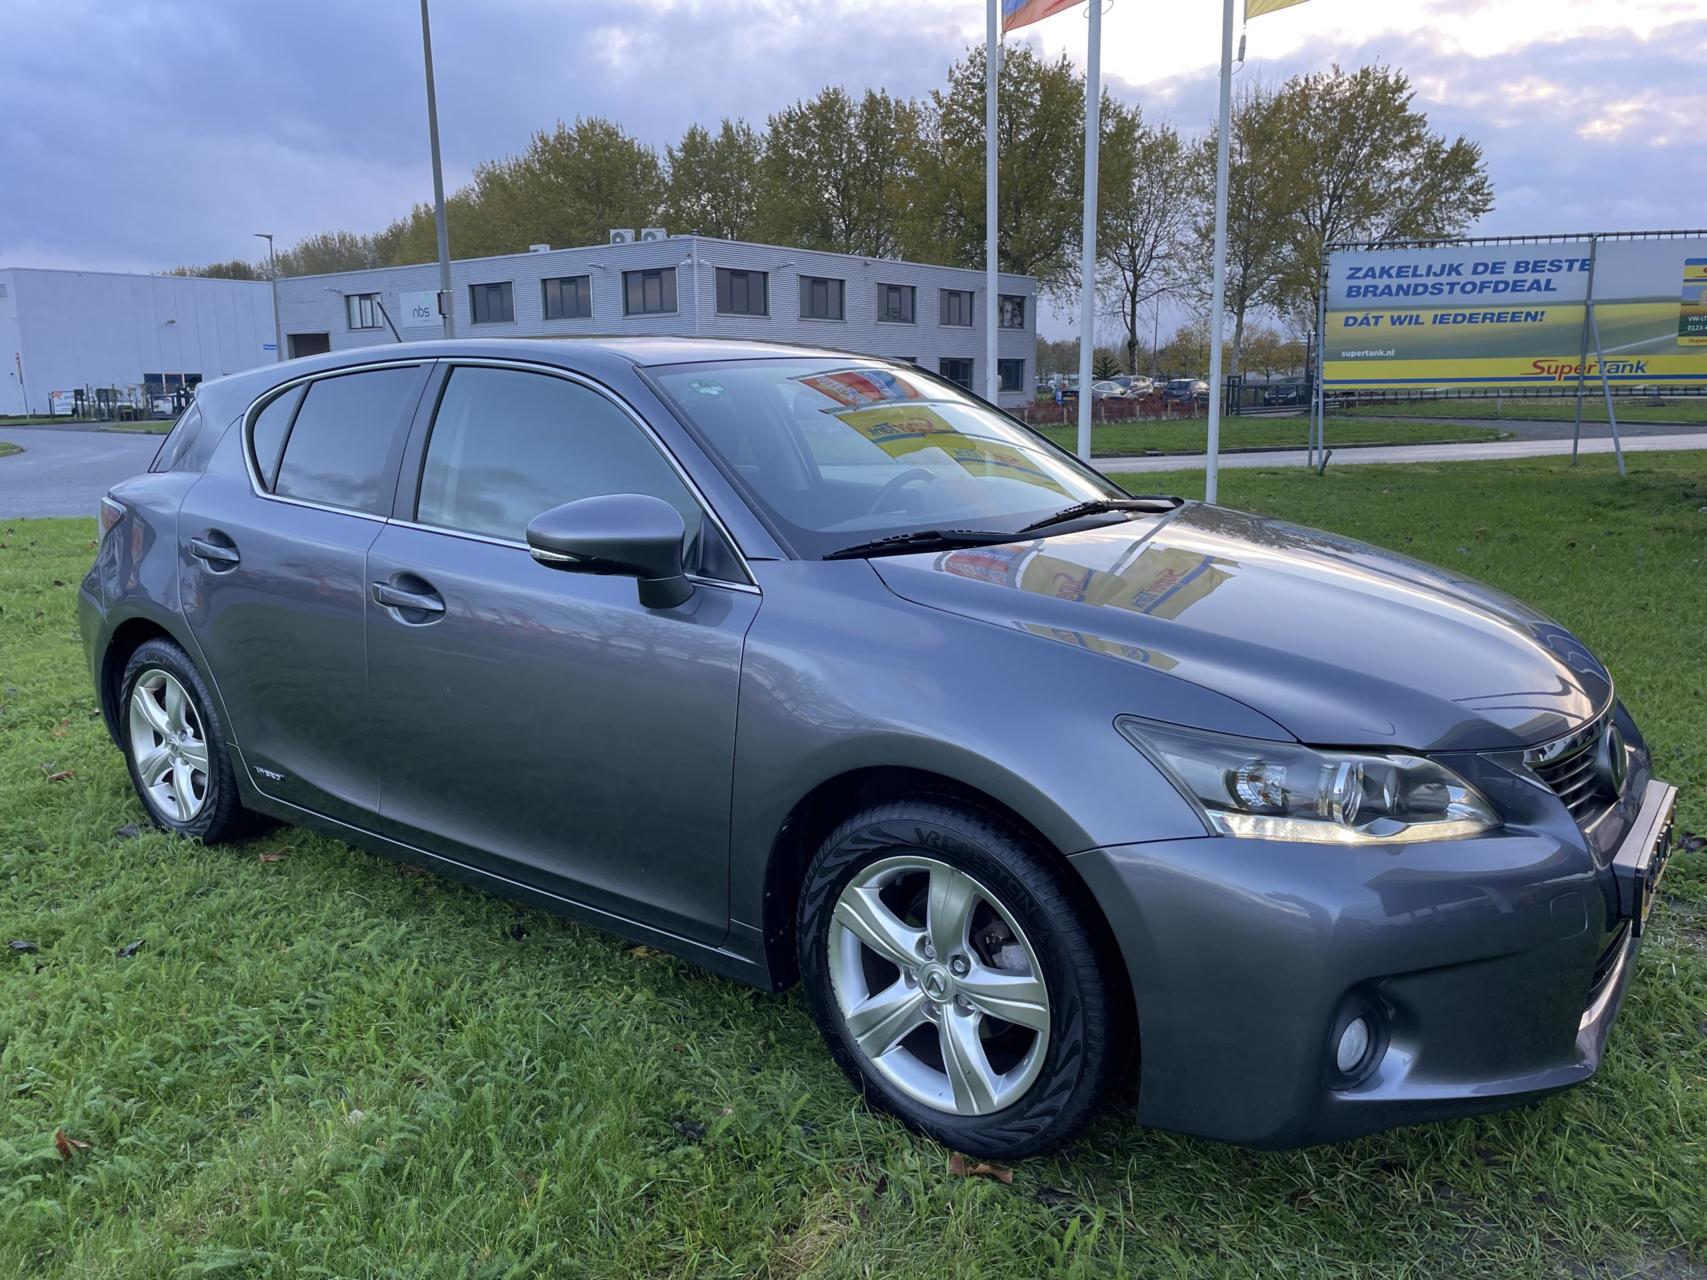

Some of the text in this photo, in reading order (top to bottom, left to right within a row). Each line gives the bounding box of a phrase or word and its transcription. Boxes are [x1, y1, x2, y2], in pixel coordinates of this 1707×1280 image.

[1346, 258, 1592, 280] ZAKELIJK DE BESTE
[1345, 279, 1557, 298] BRANDSTOFDEAL
[412, 305, 430, 318] nbs
[1343, 310, 1546, 327] DÁT WIL IEDEREEN!
[1341, 348, 1395, 358] supertank.nl
